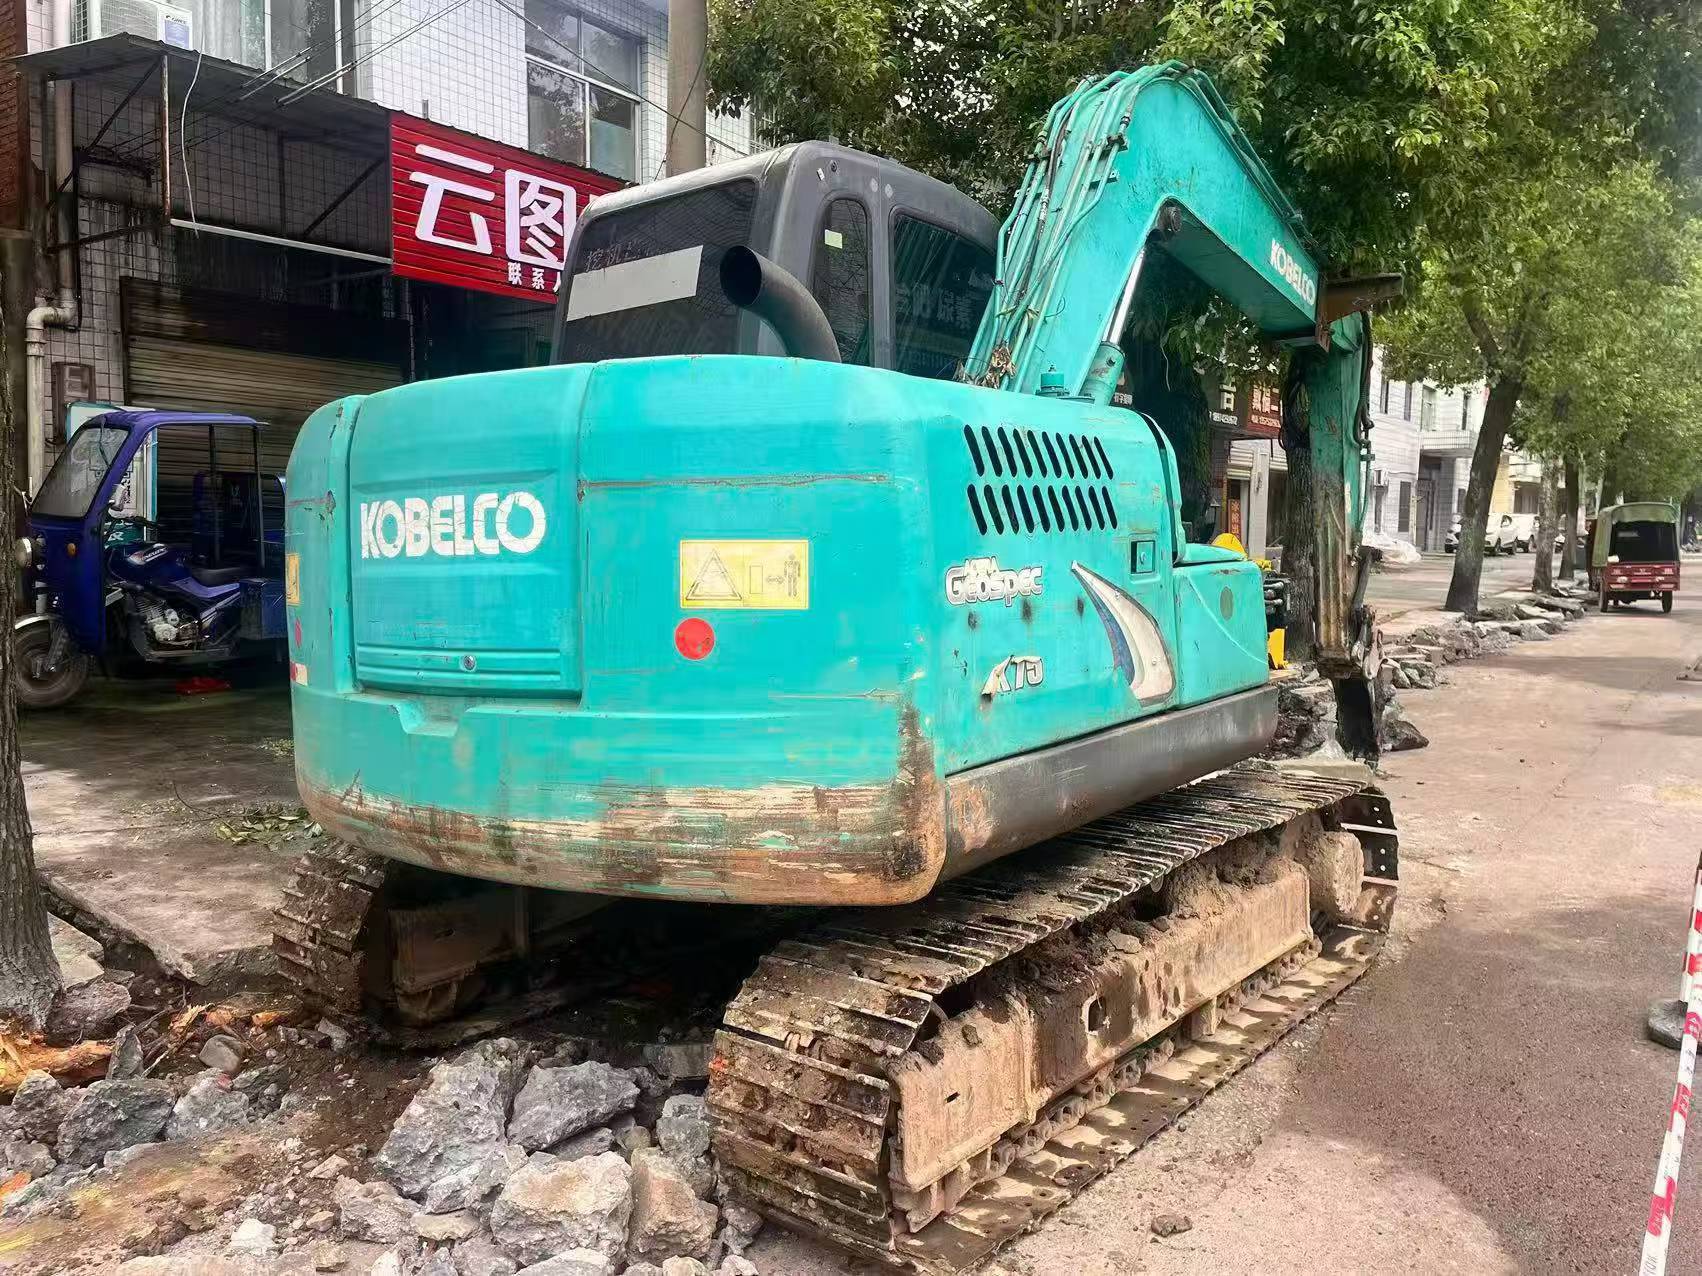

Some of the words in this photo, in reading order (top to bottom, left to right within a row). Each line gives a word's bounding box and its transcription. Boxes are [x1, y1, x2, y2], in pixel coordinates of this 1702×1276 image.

[409, 143, 602, 271] 云图
[1270, 237, 1316, 306] KOBELCO
[360, 491, 547, 560] KOBELCO
